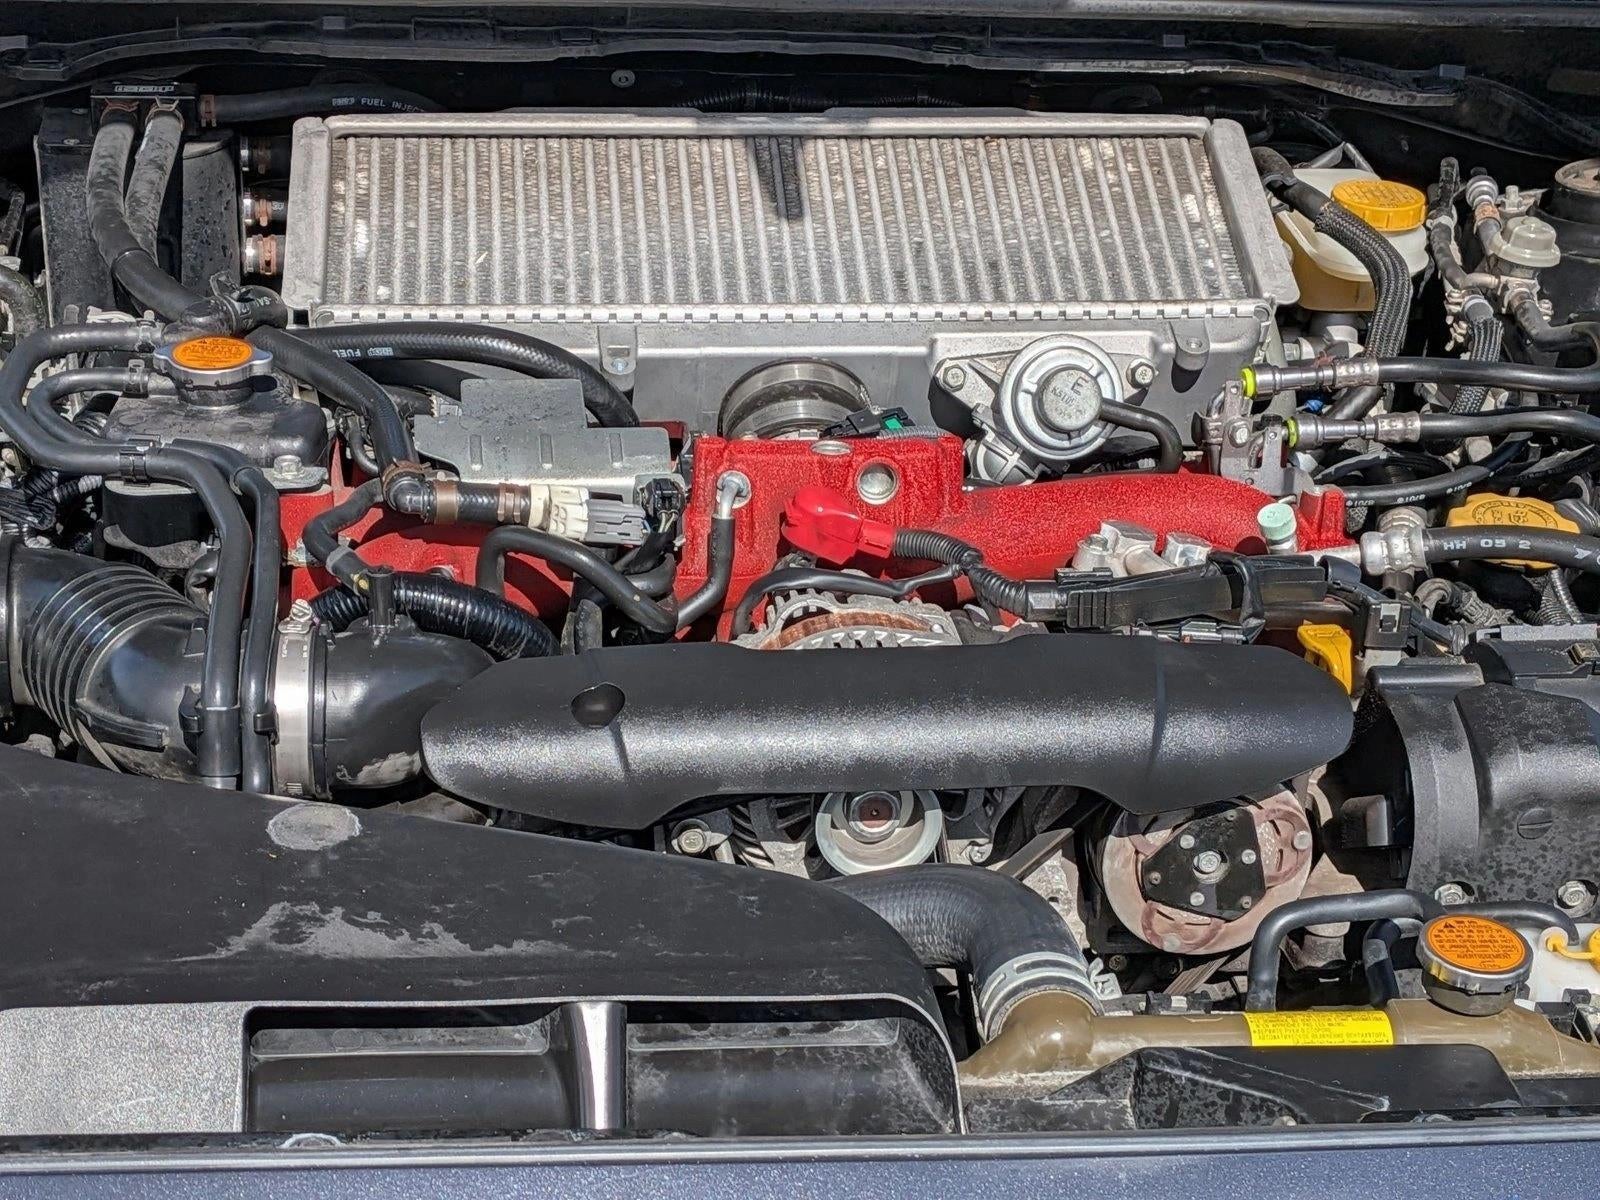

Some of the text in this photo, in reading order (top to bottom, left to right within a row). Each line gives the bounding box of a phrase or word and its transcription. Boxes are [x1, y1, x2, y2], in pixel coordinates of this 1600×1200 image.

[360, 97, 386, 107] FUEL
[391, 101, 425, 112] INJEC
[332, 348, 361, 358] FUEL
[1443, 539, 1467, 551] HH
[1518, 539, 1531, 549] 2
